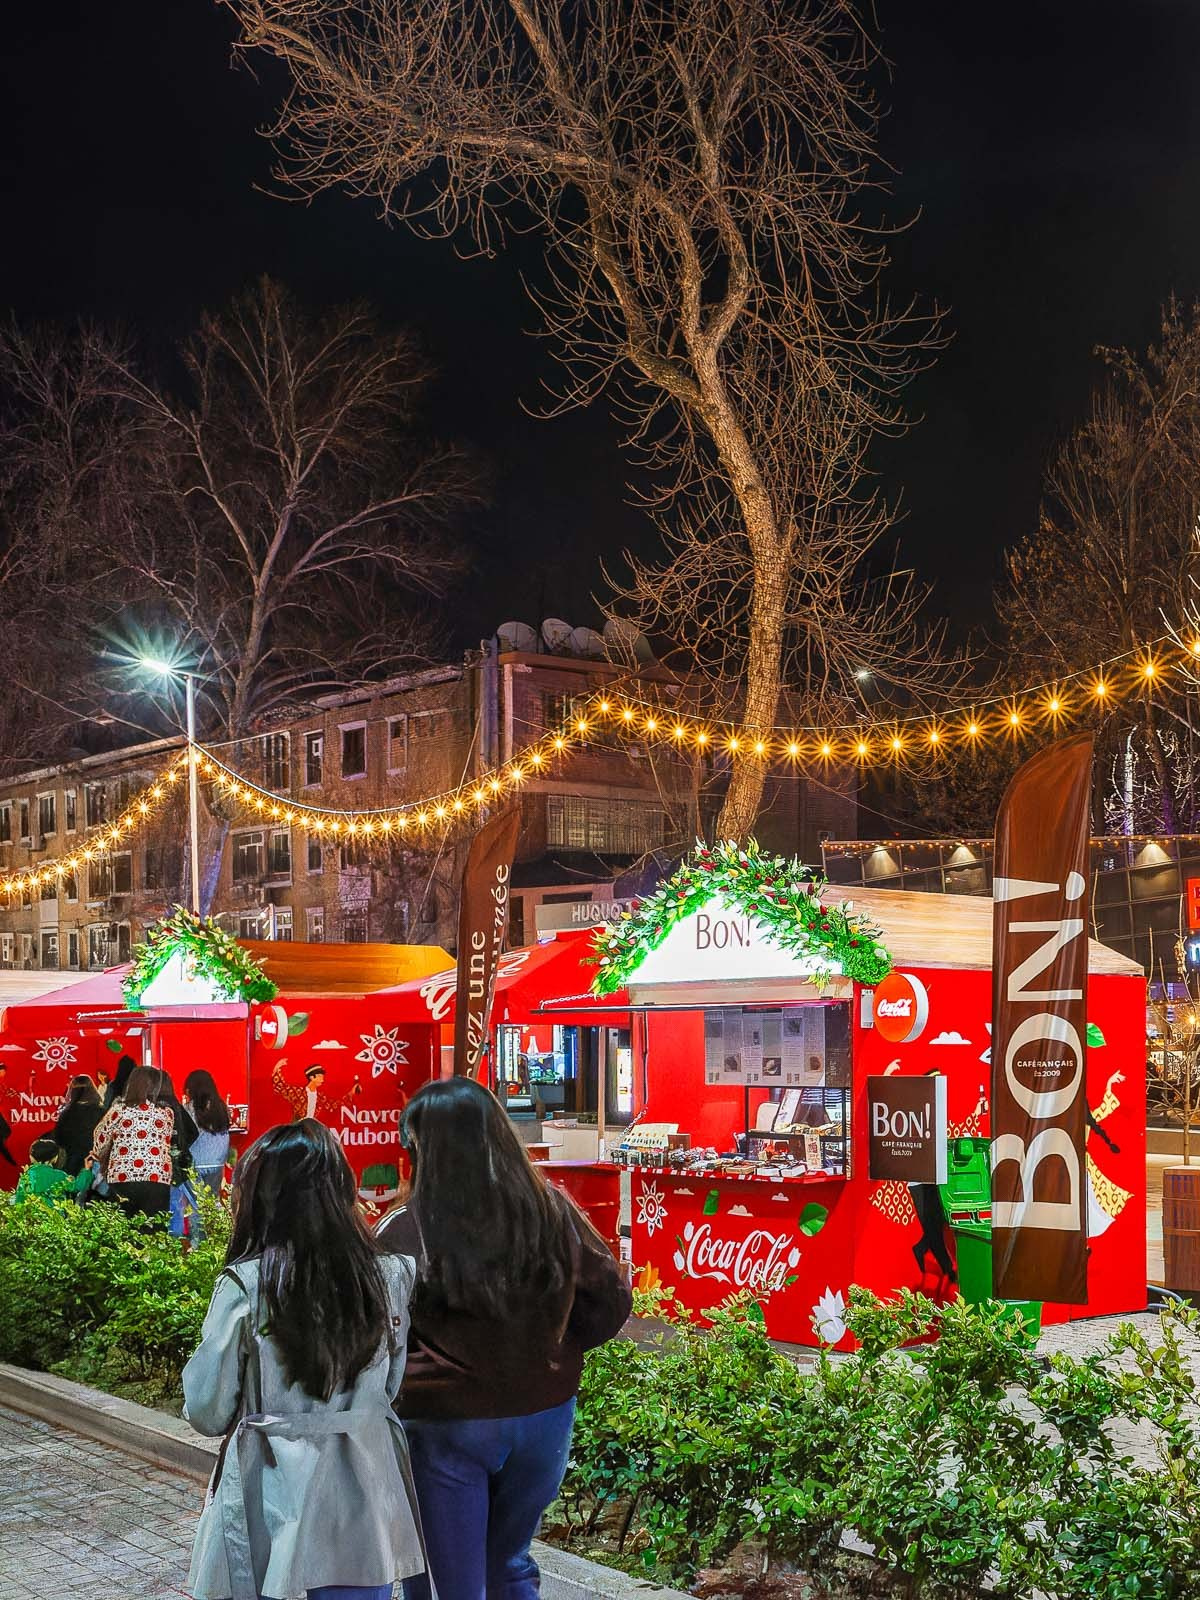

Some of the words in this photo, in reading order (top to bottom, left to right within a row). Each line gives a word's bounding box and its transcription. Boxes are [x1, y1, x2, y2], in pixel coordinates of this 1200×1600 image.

[469, 931, 485, 1000] une
[696, 914, 750, 950] BON!
[990, 871, 1086, 1232] BON!
[872, 1102, 931, 1140] BON!
[686, 1223, 794, 1292] Coca-Cola
